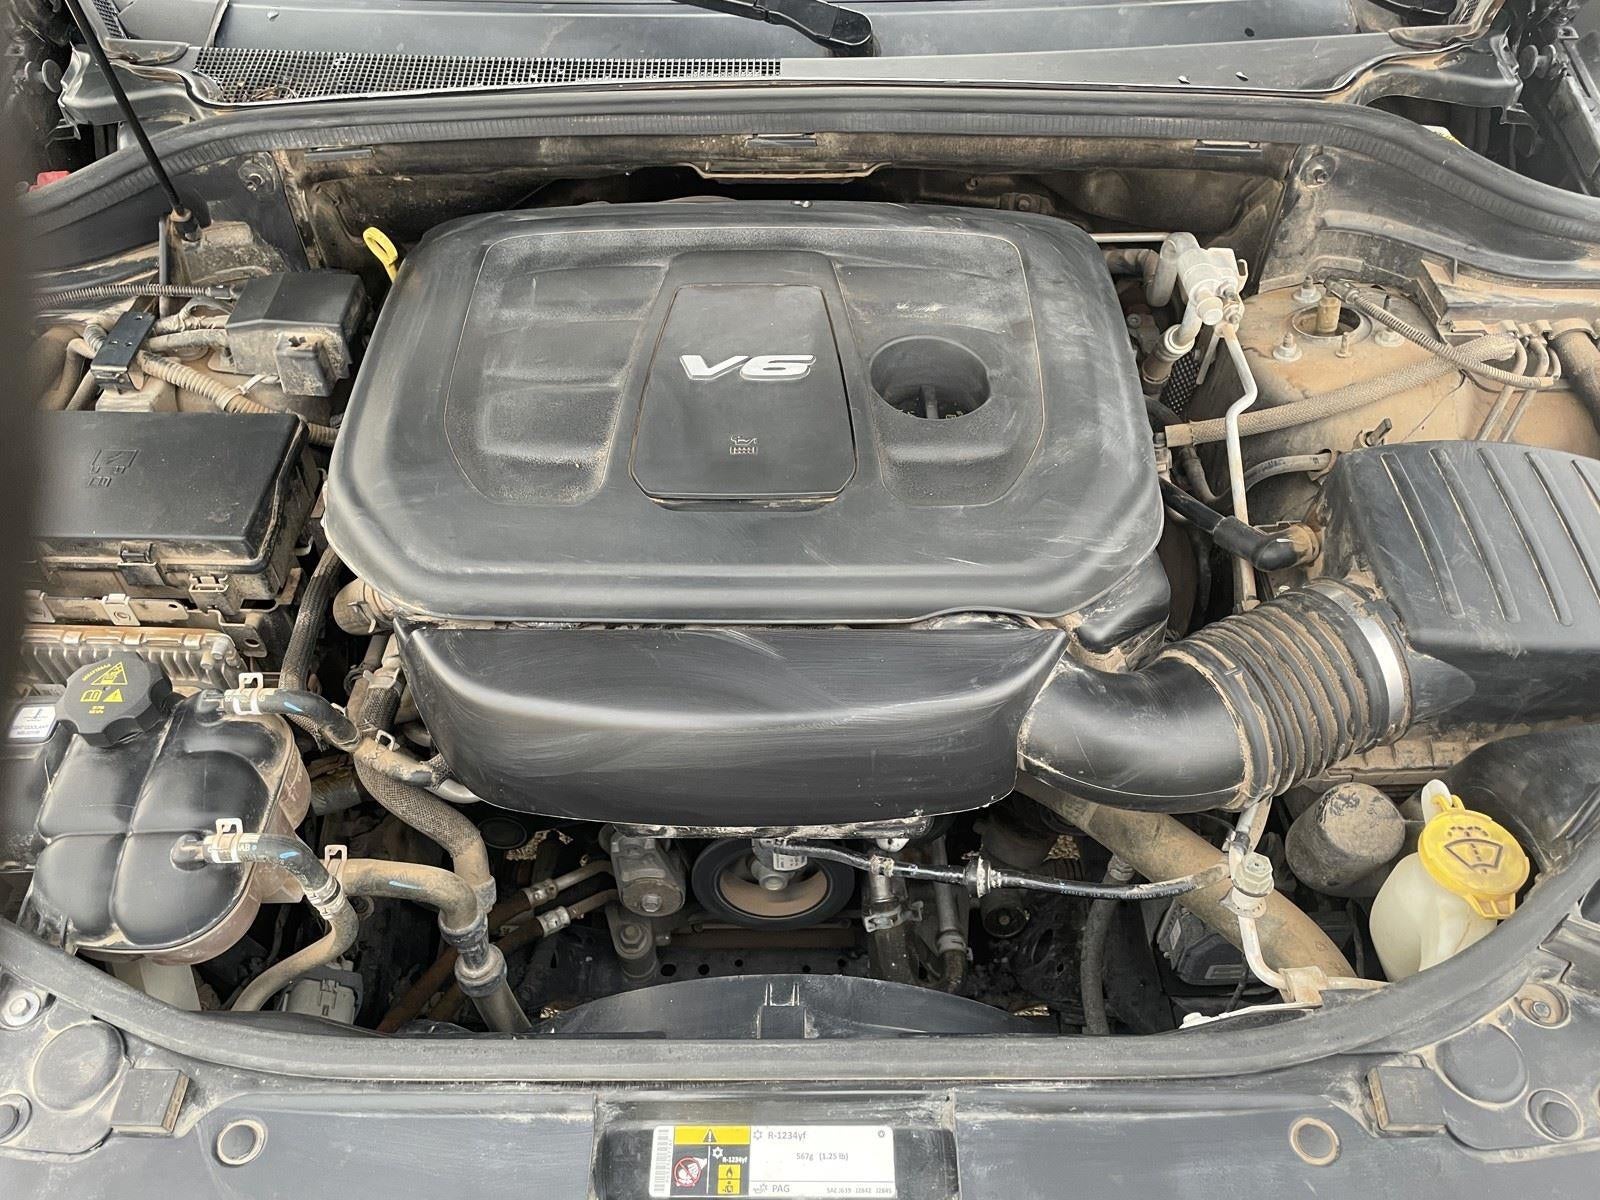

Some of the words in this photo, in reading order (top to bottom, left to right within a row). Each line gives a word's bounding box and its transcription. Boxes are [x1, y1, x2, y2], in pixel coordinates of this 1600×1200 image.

[679, 354, 817, 381] V6
[767, 1130, 807, 1141] R-1234yf
[796, 1152, 814, 1161] 567g
[819, 1152, 838, 1161] (1.25
[772, 1184, 790, 1193] PAG
